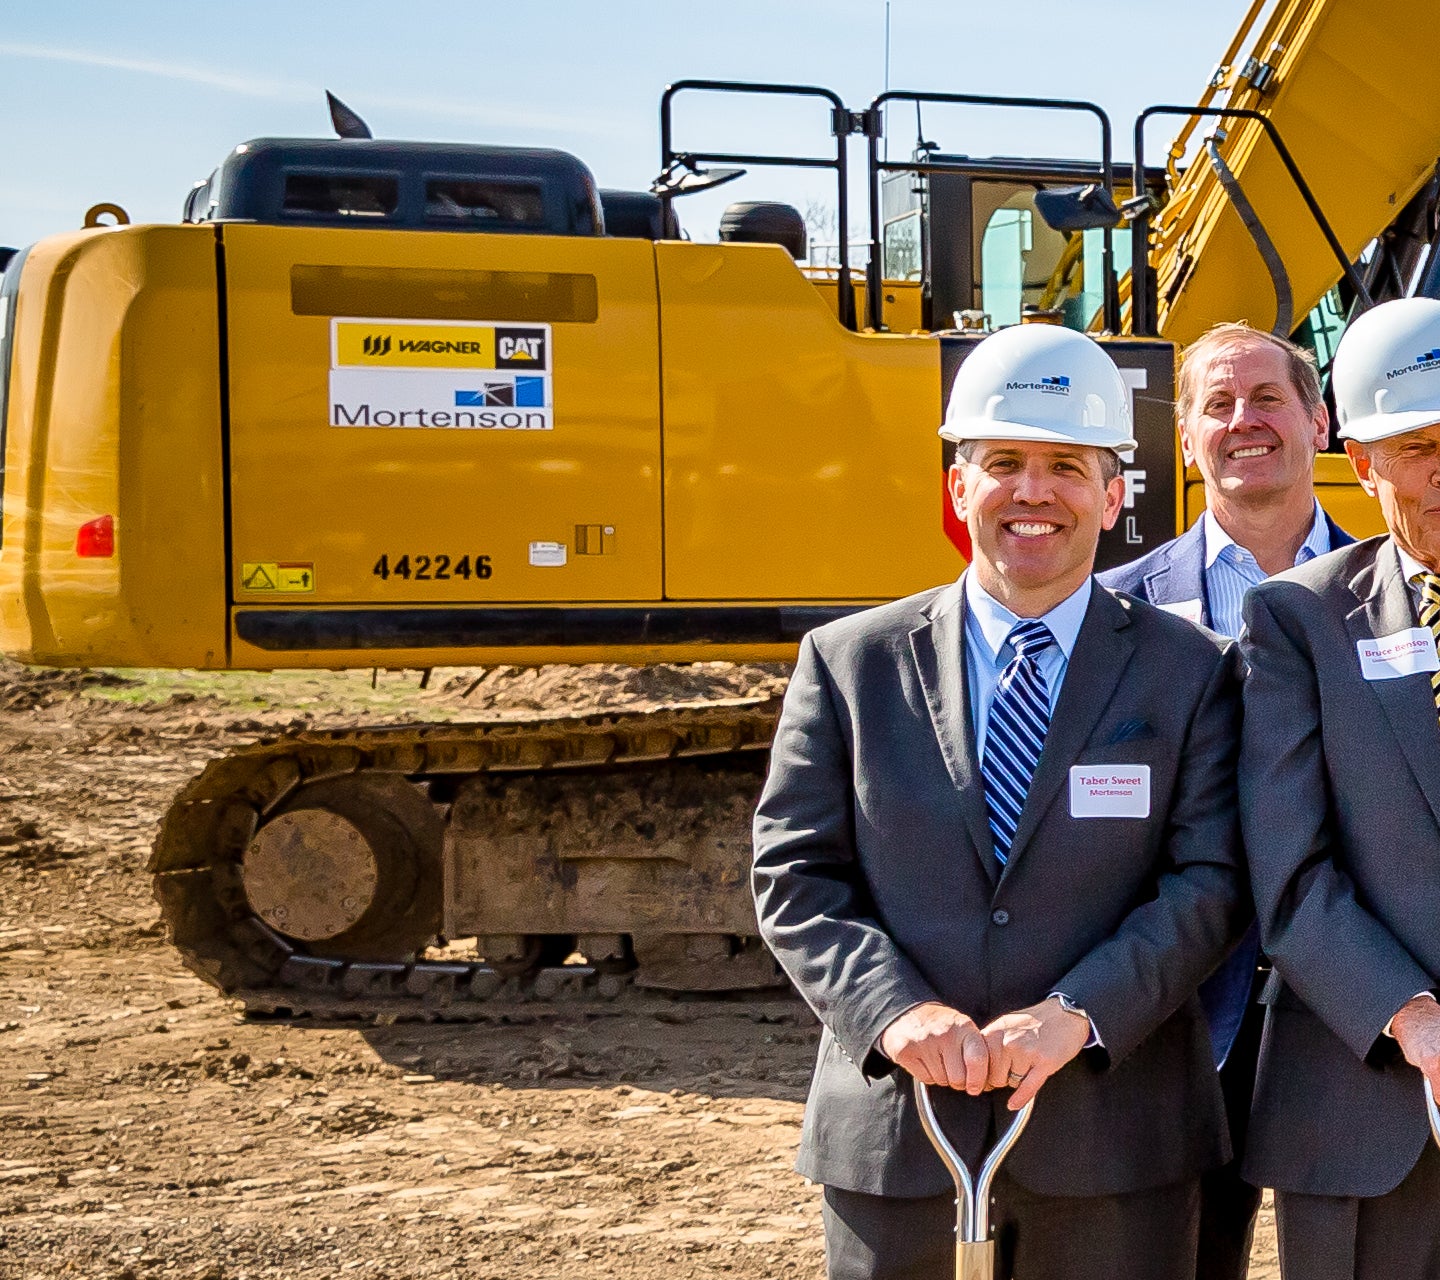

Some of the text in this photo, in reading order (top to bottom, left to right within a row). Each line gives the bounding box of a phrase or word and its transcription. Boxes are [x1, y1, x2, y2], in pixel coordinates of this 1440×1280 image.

[398, 336, 542, 360] WAGNER CAT
[1006, 381, 1070, 393] Mortenson
[333, 404, 546, 429] Mortenson
[372, 554, 493, 581] 442246
[1365, 648, 1392, 657] Bruce
[1395, 640, 1429, 651] Benson
[1080, 776, 1142, 785] Taber Sweet
